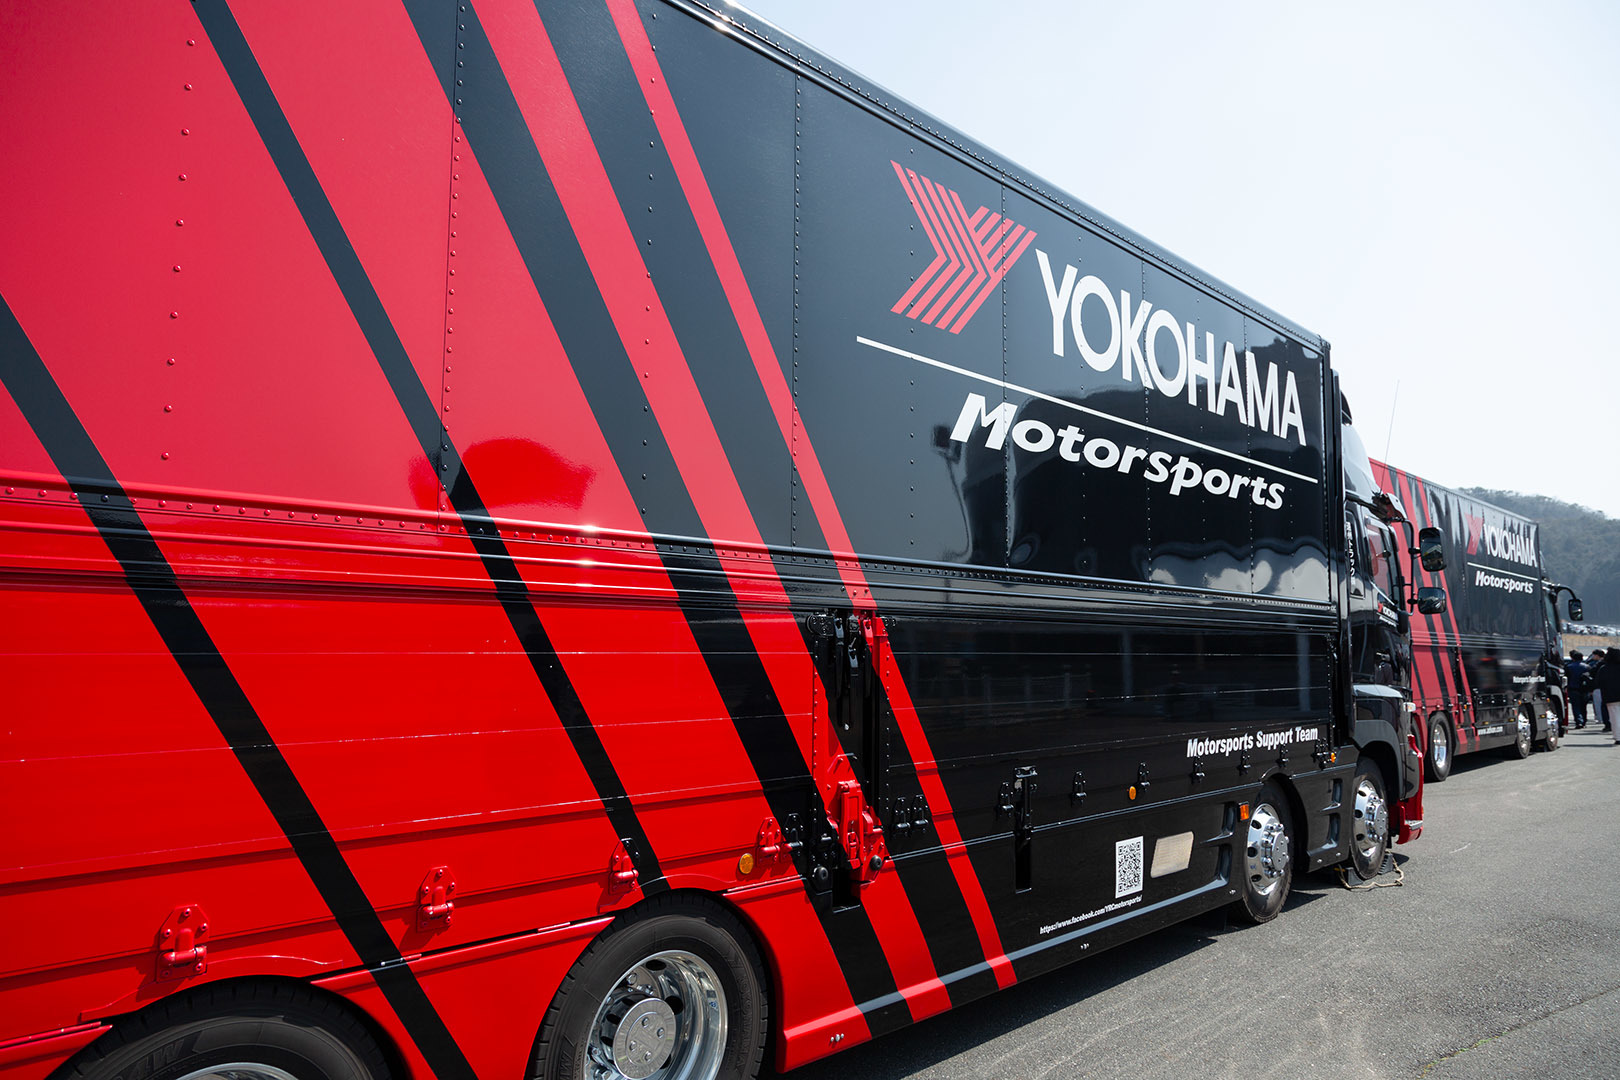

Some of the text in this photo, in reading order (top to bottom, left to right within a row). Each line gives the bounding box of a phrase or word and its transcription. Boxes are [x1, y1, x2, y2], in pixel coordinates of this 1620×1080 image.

[1035, 248, 1306, 446] YOKOHAMA
[949, 392, 1286, 510] Motorsports
[1483, 523, 1538, 568] YOKOHAMA
[1475, 570, 1534, 594] Motorsports
[1186, 726, 1318, 757] Motorsports Support Team
